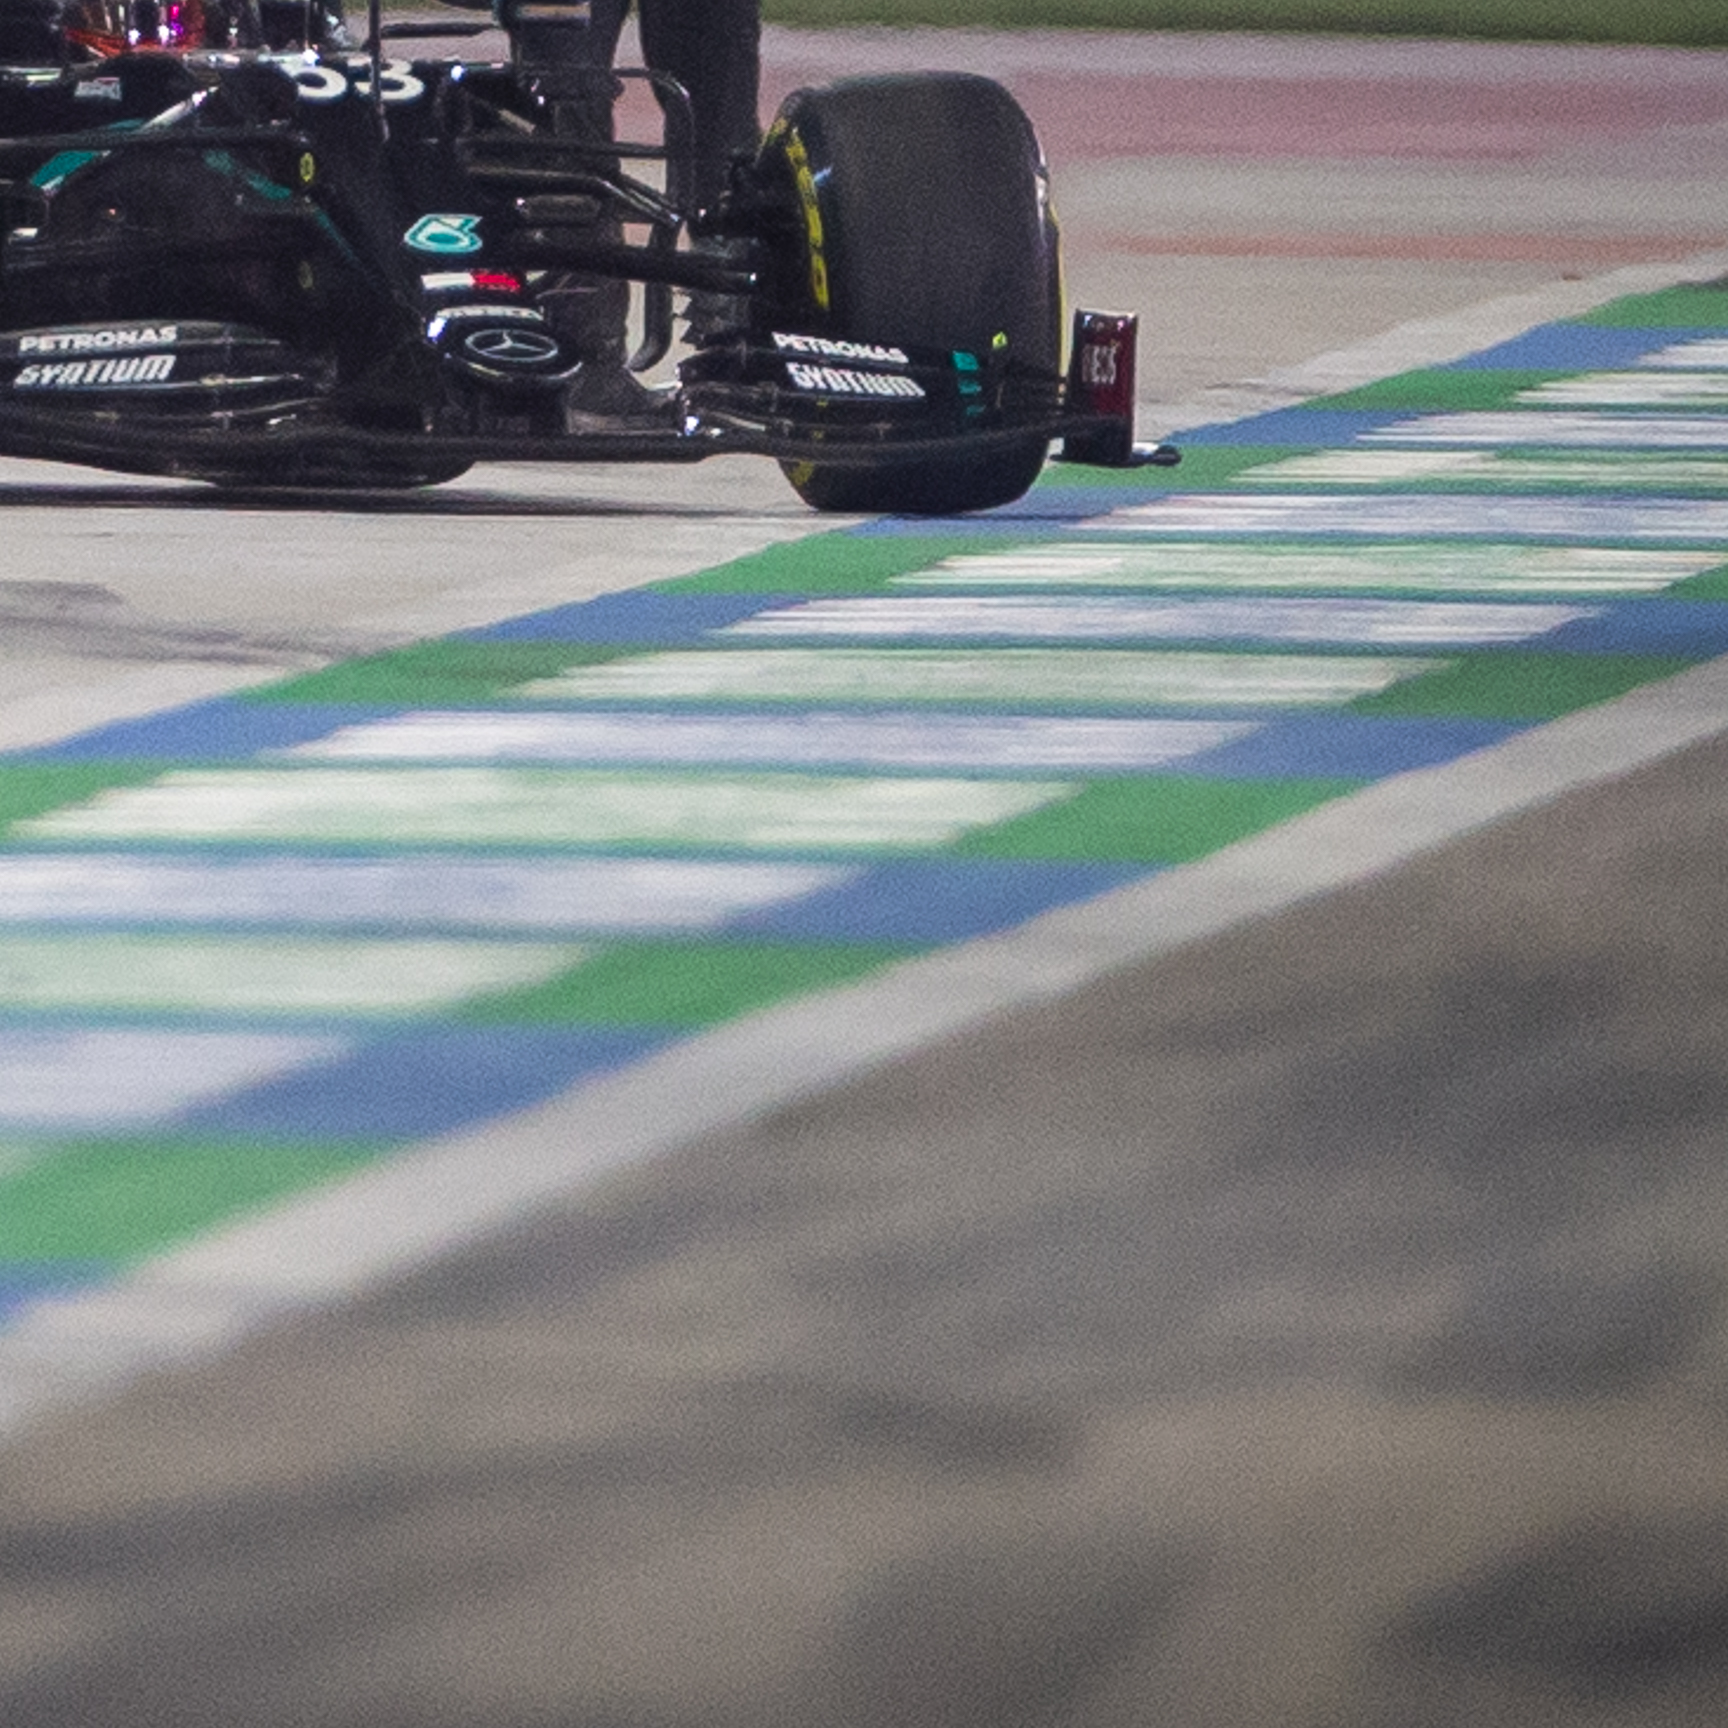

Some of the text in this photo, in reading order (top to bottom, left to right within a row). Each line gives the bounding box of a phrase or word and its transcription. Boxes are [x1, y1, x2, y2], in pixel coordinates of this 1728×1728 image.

[18, 325, 179, 354] PETRONAS
[771, 329, 910, 365] PETRONAS
[12, 353, 178, 388] SYNTIUM
[784, 360, 928, 399] SYNTIUM
